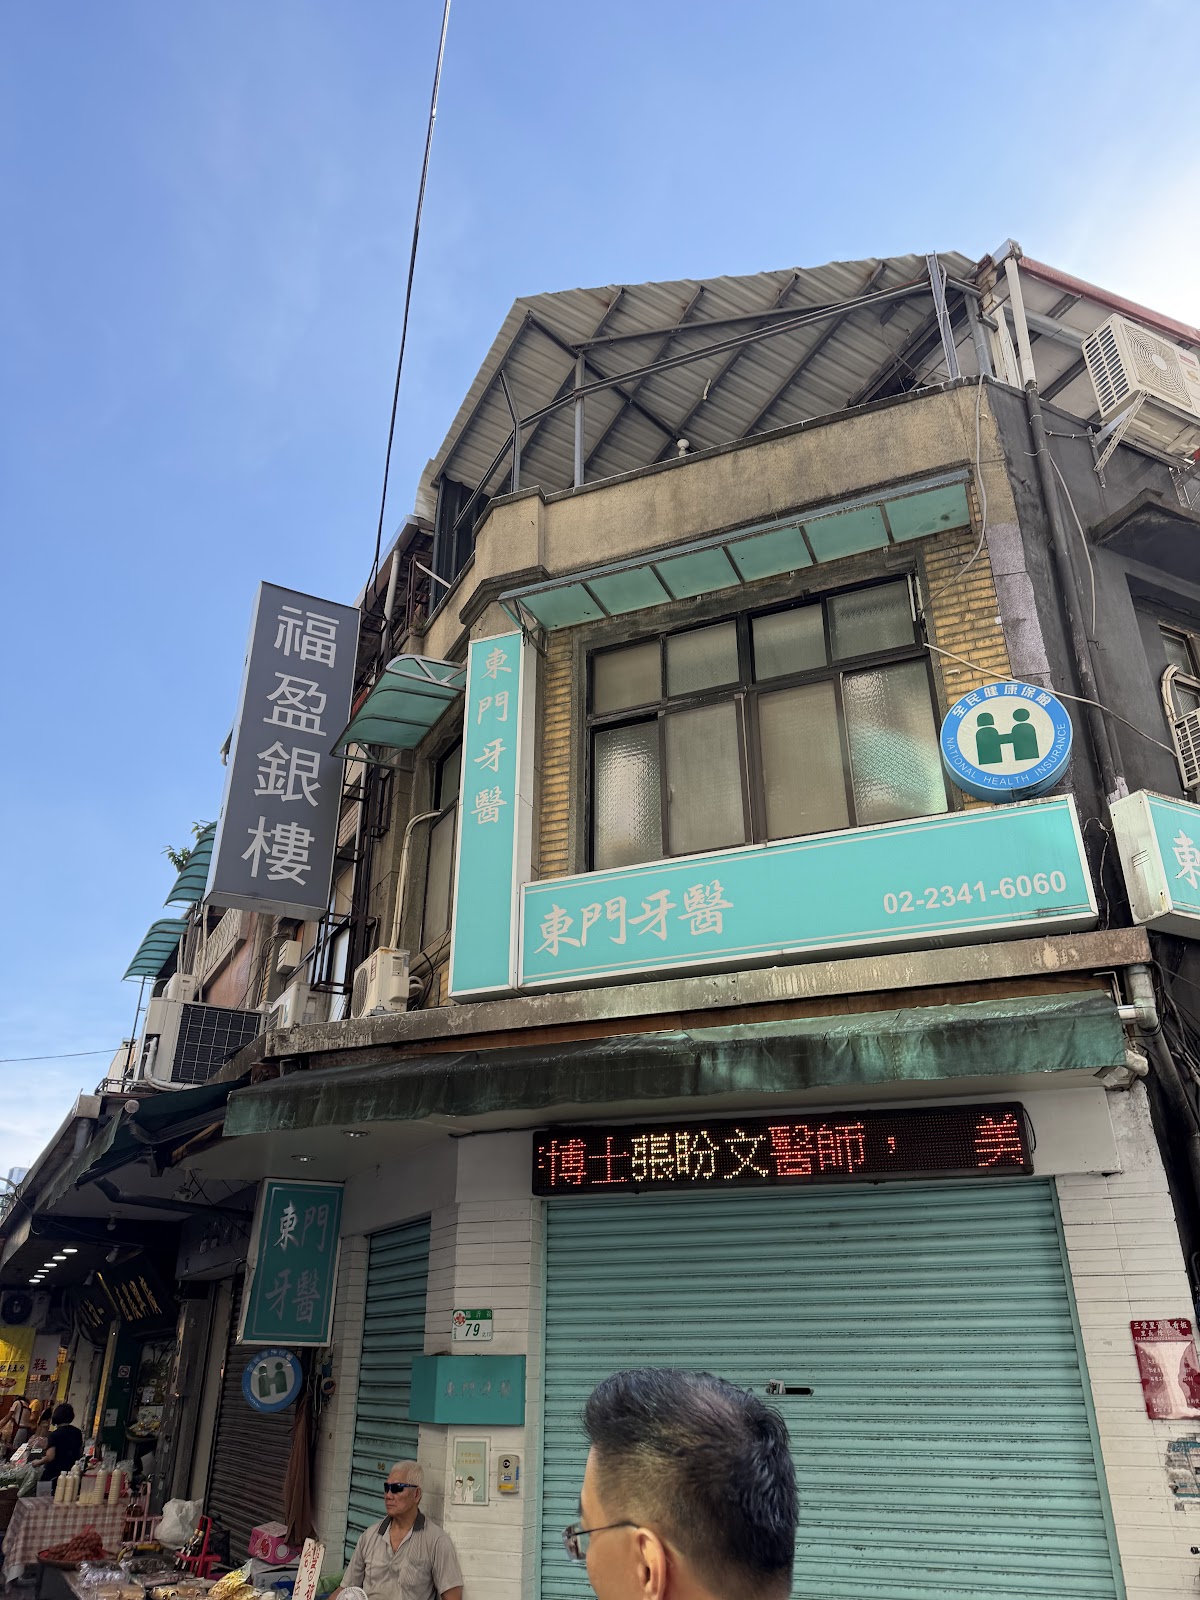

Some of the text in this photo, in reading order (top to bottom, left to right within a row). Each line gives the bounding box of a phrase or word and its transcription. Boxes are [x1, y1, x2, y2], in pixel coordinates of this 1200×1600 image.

[951, 683, 1053, 719] 全民健康保險
[241, 605, 340, 886] 福盈銀樓
[470, 647, 513, 825] 東門牙醫
[946, 722, 1067, 786] NATIONAL HEALTH INSURANCE
[534, 879, 734, 957] 東門牙醫
[883, 870, 1067, 915] 02-2341-6060
[273, 1200, 330, 1252] 東門
[265, 1268, 321, 1323] 牙醫
[465, 1323, 481, 1337] 79
